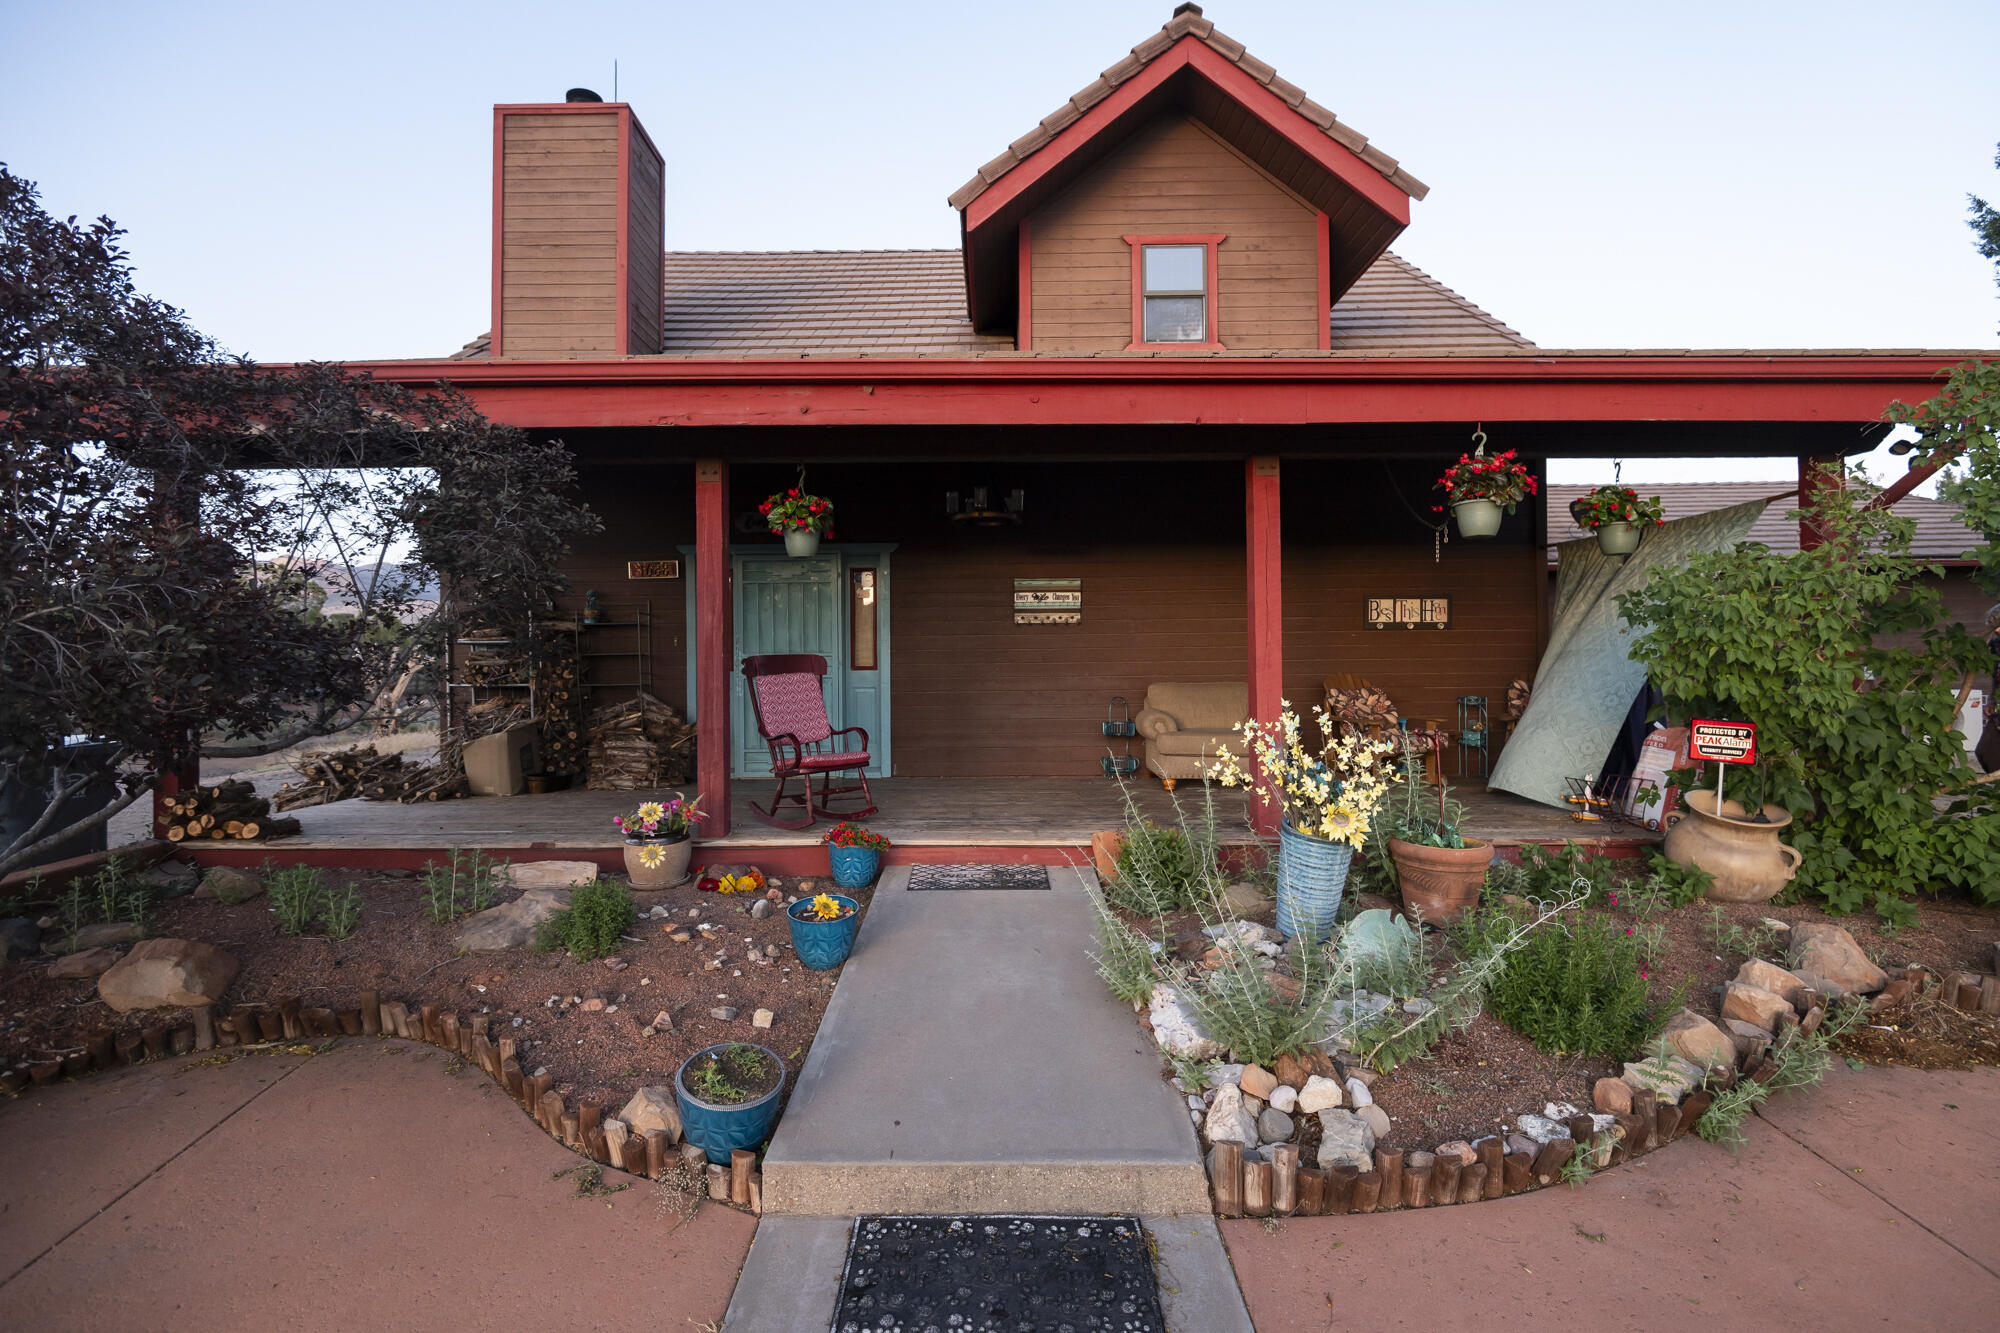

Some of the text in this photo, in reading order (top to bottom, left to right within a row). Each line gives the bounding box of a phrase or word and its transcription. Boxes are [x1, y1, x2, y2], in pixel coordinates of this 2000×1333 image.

[1396, 599, 1420, 622] This
[1699, 727, 1736, 736] PROTECTED
[1722, 748, 1743, 756] SERVICES
